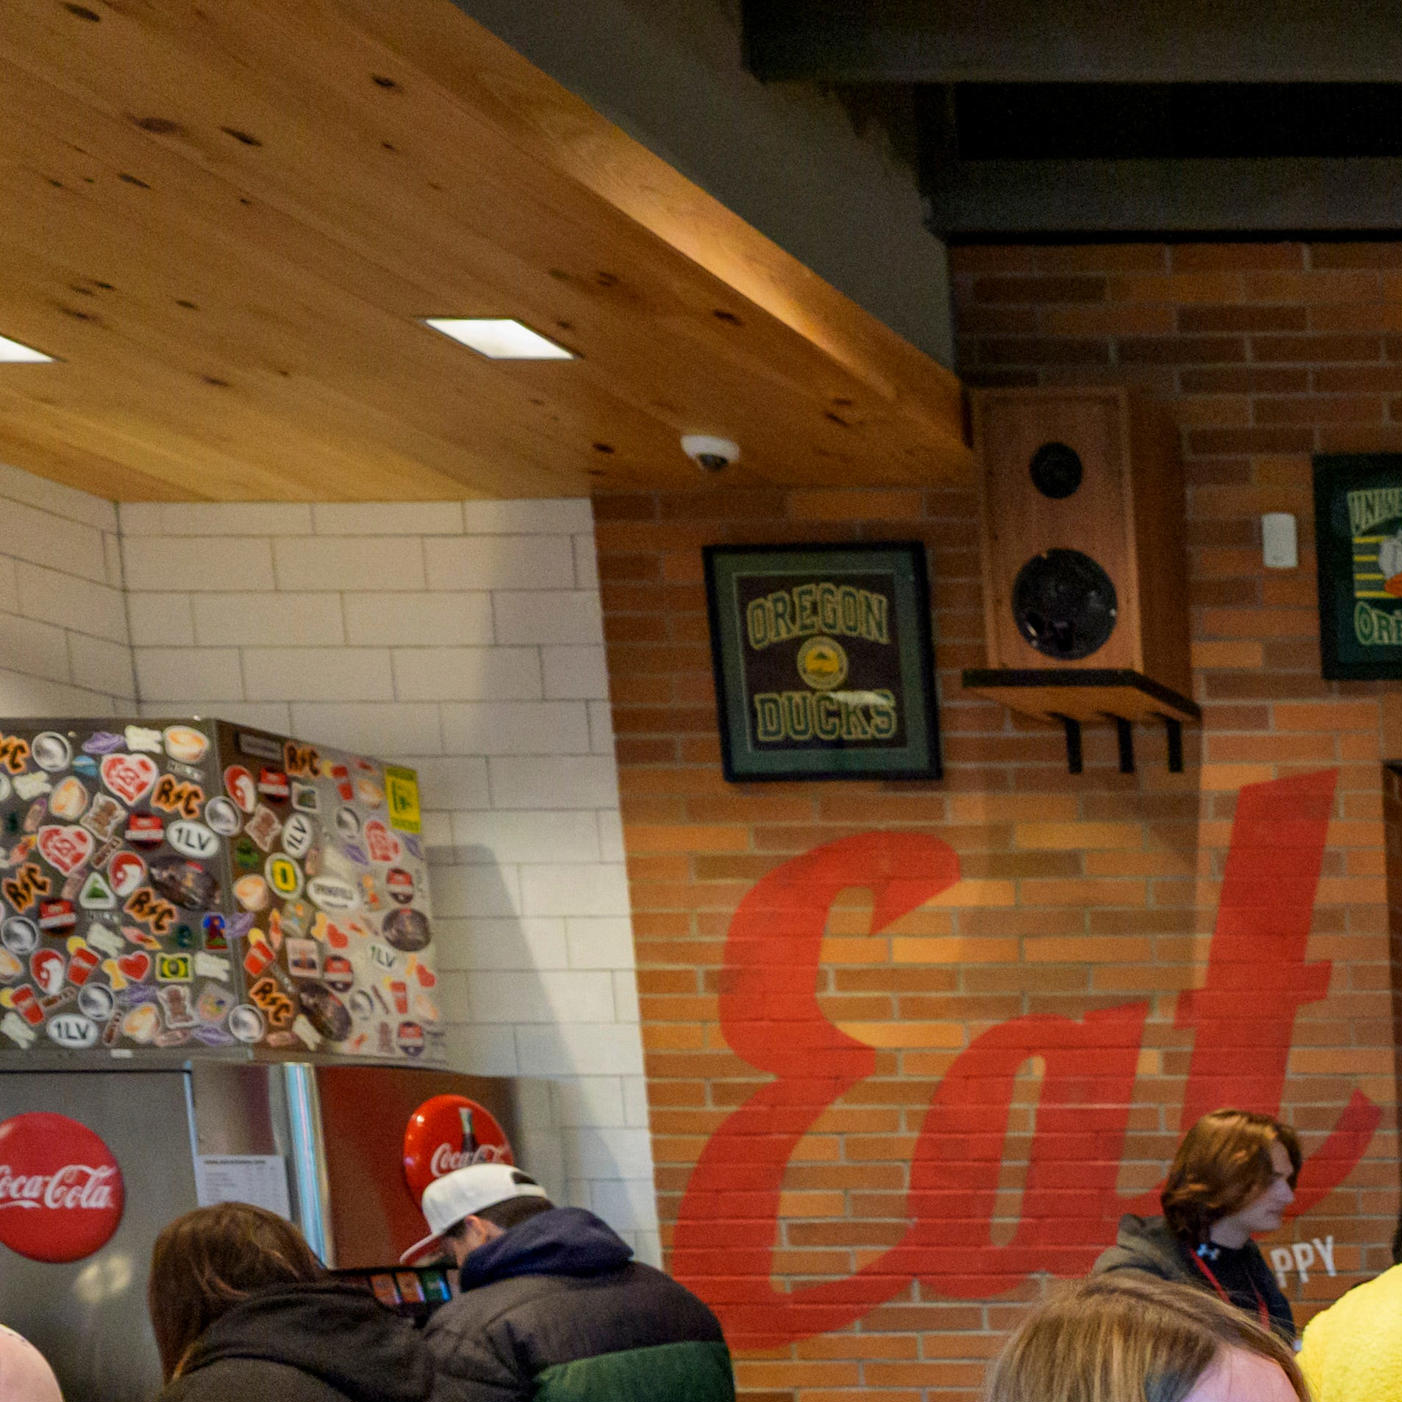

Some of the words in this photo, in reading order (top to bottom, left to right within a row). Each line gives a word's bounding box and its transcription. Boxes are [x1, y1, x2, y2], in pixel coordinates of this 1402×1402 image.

[746, 581, 891, 651] OREGON
[753, 688, 899, 743] DUCKS
[669, 767, 1384, 1352] Eat
[1269, 1234, 1338, 1289] PPY
